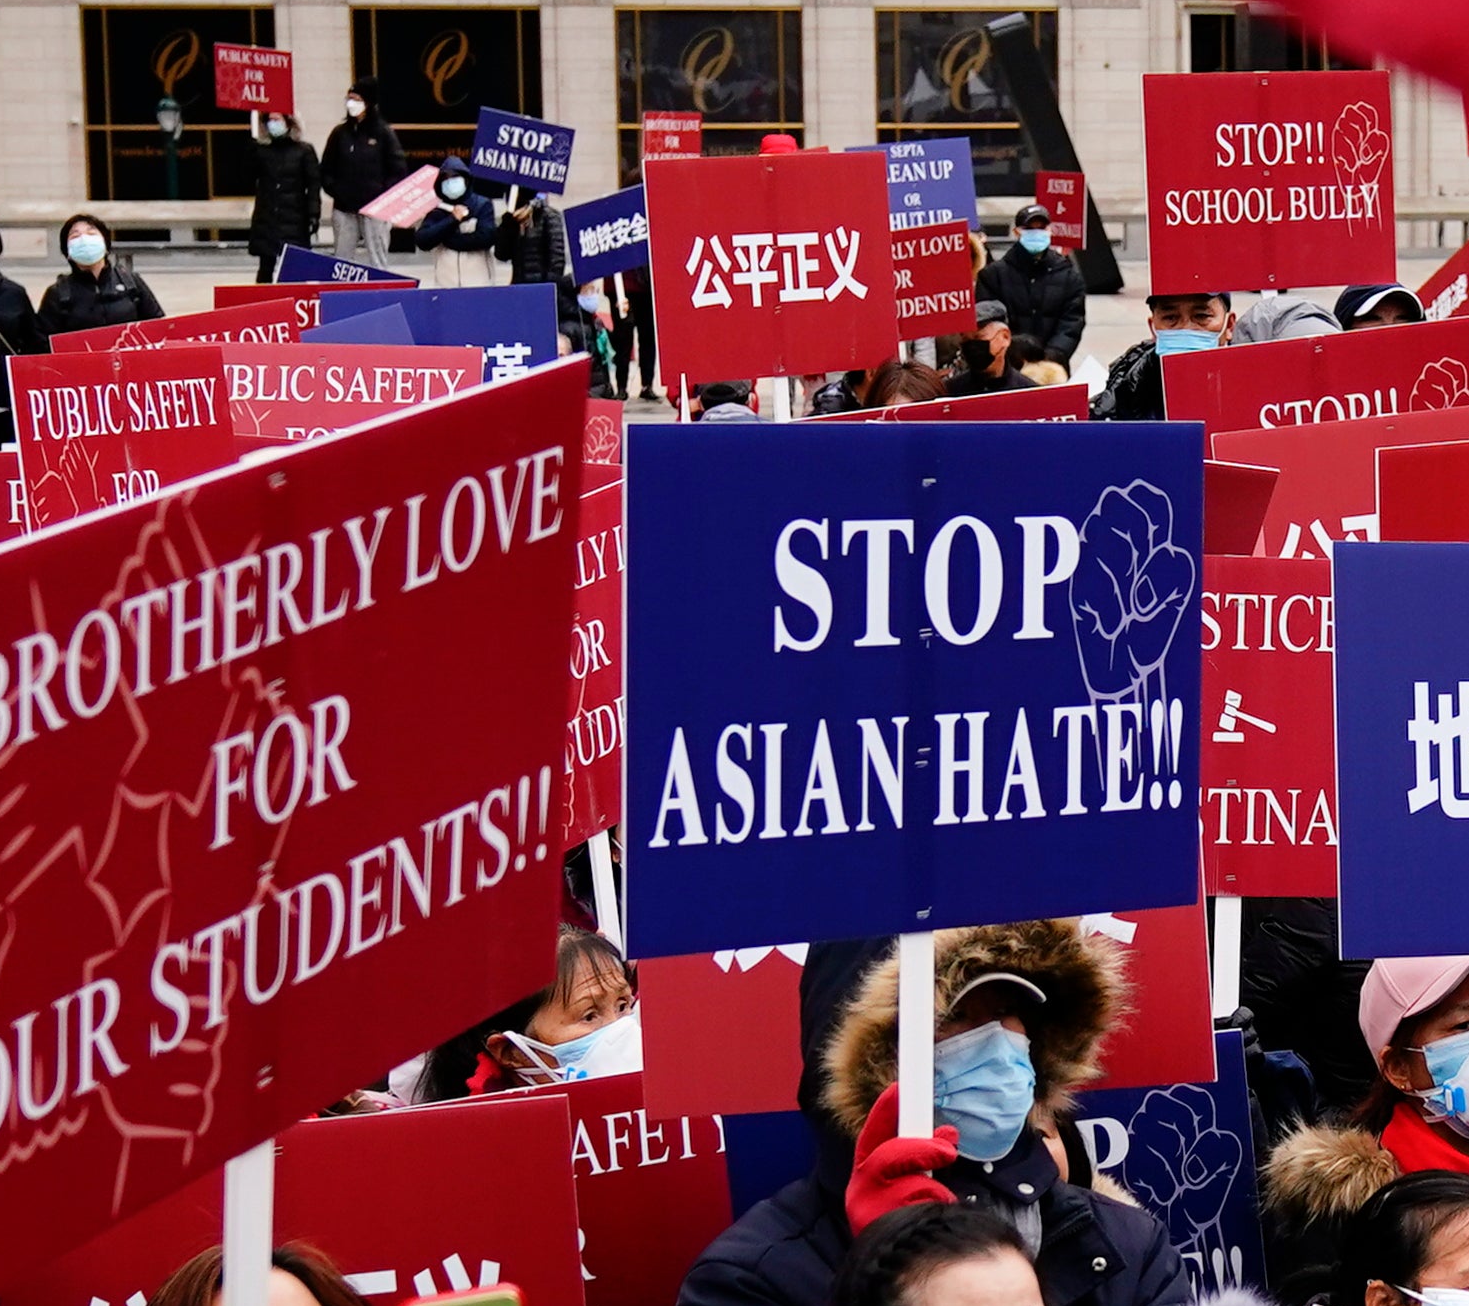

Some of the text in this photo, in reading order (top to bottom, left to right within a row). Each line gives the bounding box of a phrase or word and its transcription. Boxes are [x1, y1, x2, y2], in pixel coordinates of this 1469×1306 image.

[218, 49, 291, 70] PUBLIC SAFETY
[244, 69, 265, 83] FOR
[241, 84, 271, 104] ALL
[497, 123, 553, 155] STOP
[889, 144, 926, 159] SEPTA
[1215, 121, 1326, 169] STOP!!
[474, 147, 519, 172] ASIAN
[519, 157, 568, 184] HATE!!
[886, 160, 954, 183] EAN UP
[904, 193, 922, 207] OR
[1165, 182, 1380, 227] SCHOOL BULLY
[889, 210, 926, 232] HUT
[922, 232, 966, 258] LOVE
[332, 261, 370, 283] SEPTA
[684, 225, 870, 310] 公平正义
[295, 298, 322, 328] ST
[896, 289, 972, 320] DENTS!!
[224, 364, 466, 405] BLIC SAFETY
[28, 376, 219, 443] PUBLIC SAFETY
[400, 445, 566, 595] LOVE
[772, 514, 1083, 654] STOP
[211, 694, 360, 851] FOR
[649, 715, 909, 848] ASIAN
[931, 697, 1185, 827] HATE!!
[149, 763, 553, 1059] STUDENTS!!
